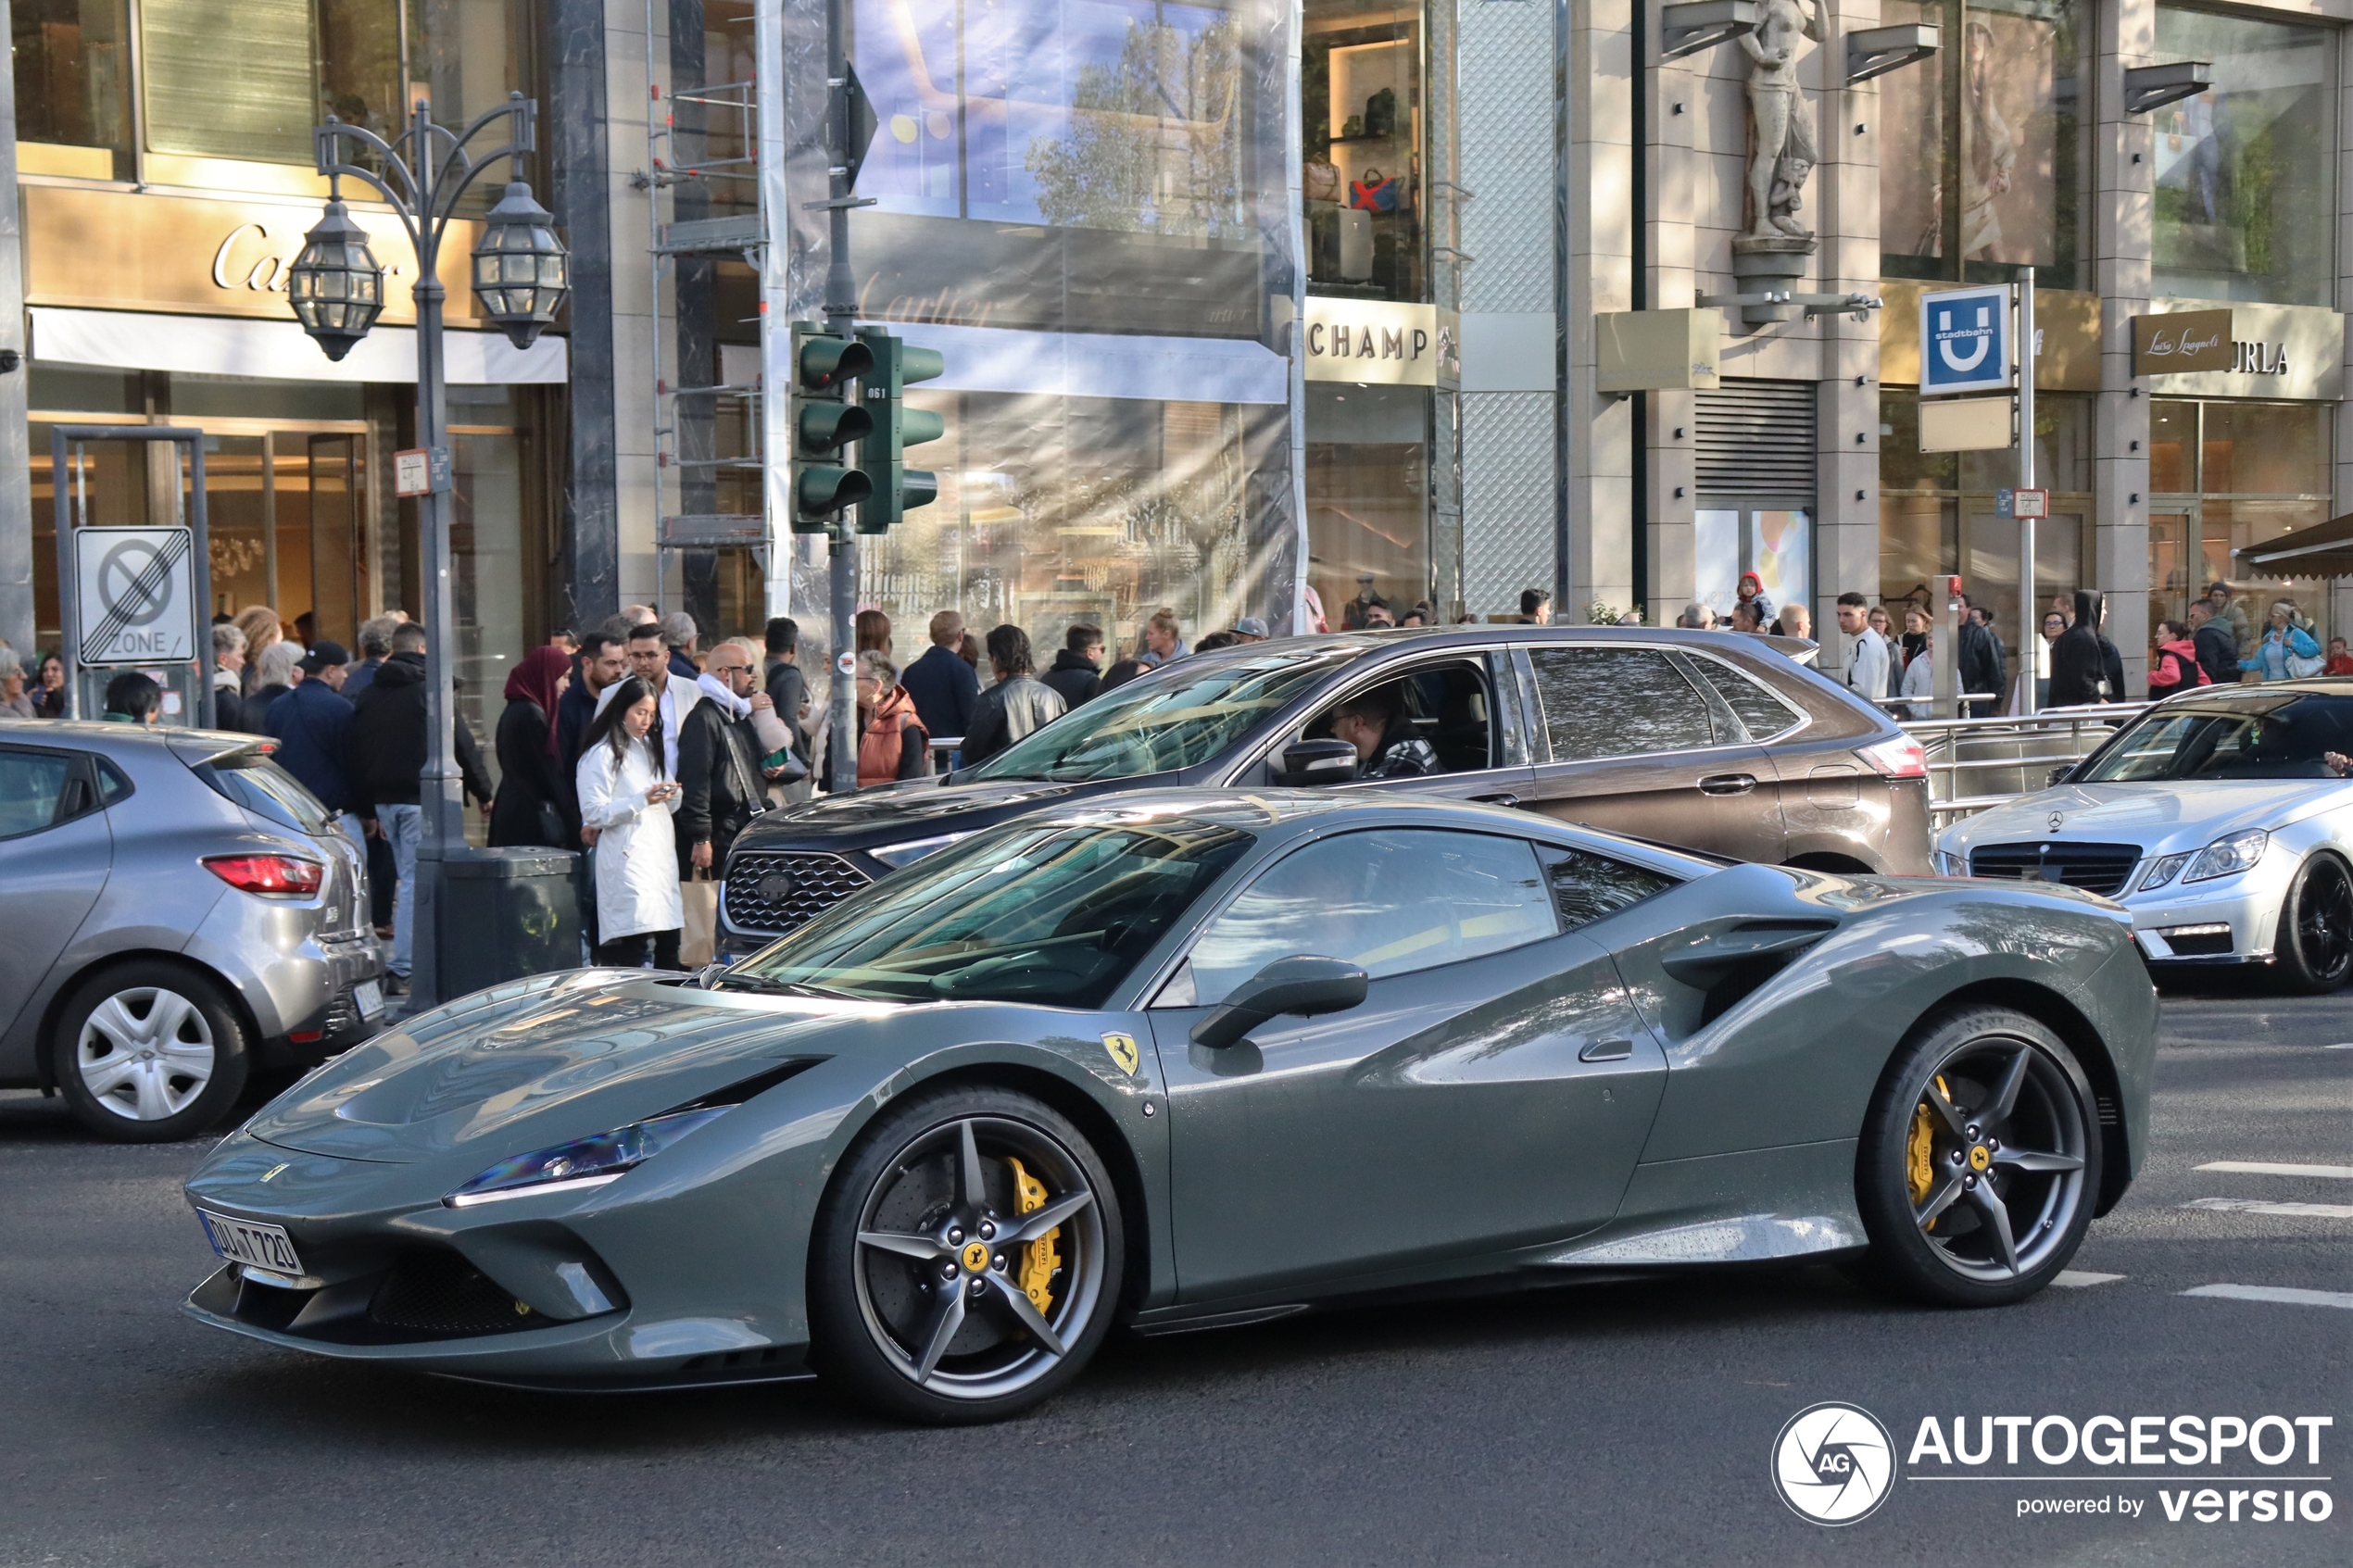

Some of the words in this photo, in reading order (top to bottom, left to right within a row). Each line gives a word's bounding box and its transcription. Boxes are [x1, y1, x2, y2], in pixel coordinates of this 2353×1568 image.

[1935, 328, 1994, 341] stadtbahn
[2144, 330, 2179, 357] Luisa
[2172, 328, 2219, 357] Spagnoli
[868, 387, 887, 399] 061
[110, 632, 166, 654] ZONE
